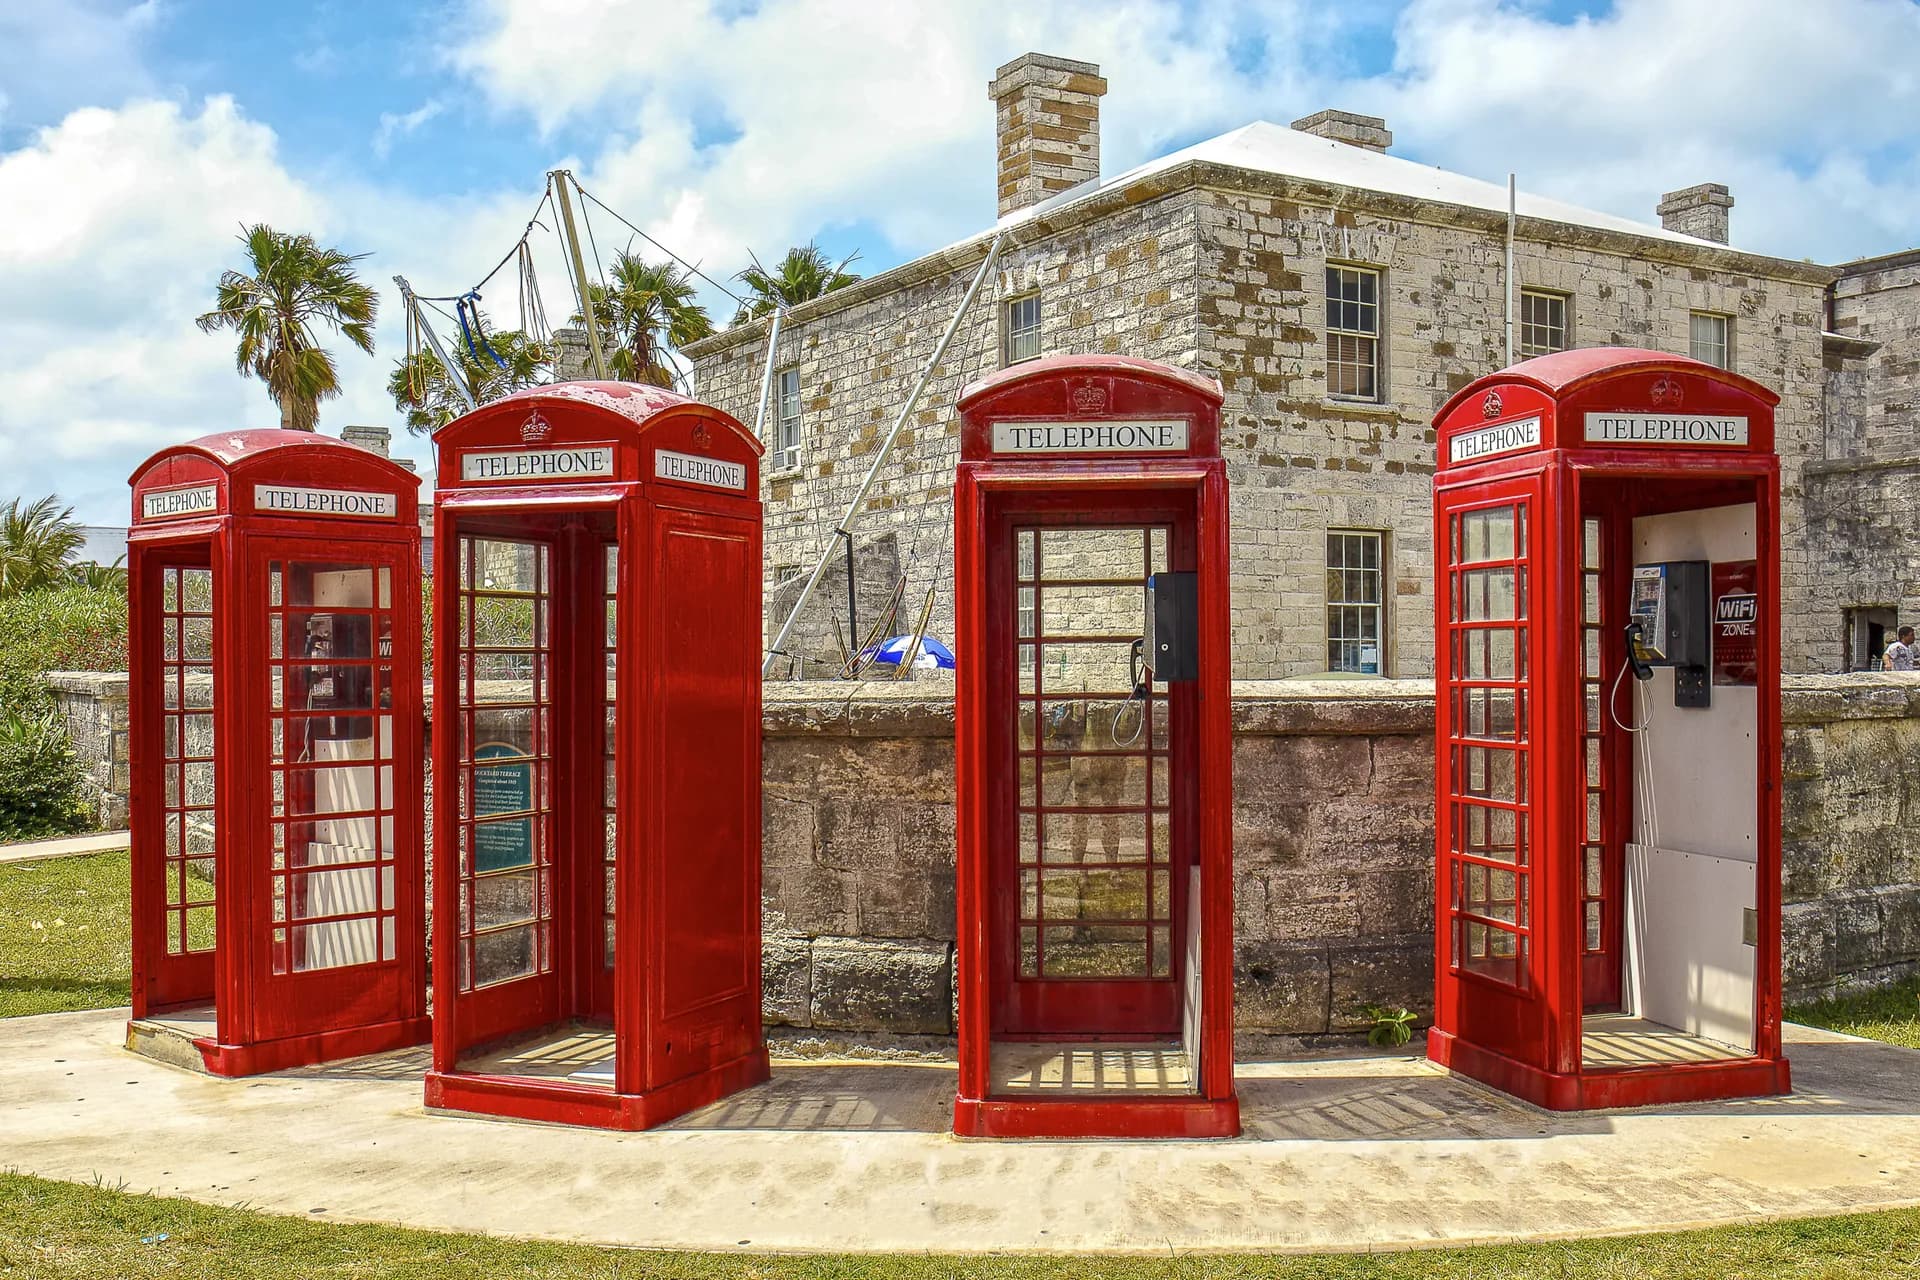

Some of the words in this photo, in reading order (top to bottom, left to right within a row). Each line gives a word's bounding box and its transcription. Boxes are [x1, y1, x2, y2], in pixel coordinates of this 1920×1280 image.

[1009, 425, 1175, 449] TELEPHONE
[1457, 422, 1535, 458] TELEPHONE
[1599, 418, 1737, 441] TELEPHONE
[475, 451, 604, 477] TELEPHONE
[661, 455, 739, 487] TELEPHONE
[149, 489, 212, 515] TELEPHONE
[265, 490, 386, 514] TELEPHONE
[1720, 600, 1755, 618] WiFi
[1722, 624, 1750, 636] ZONE
